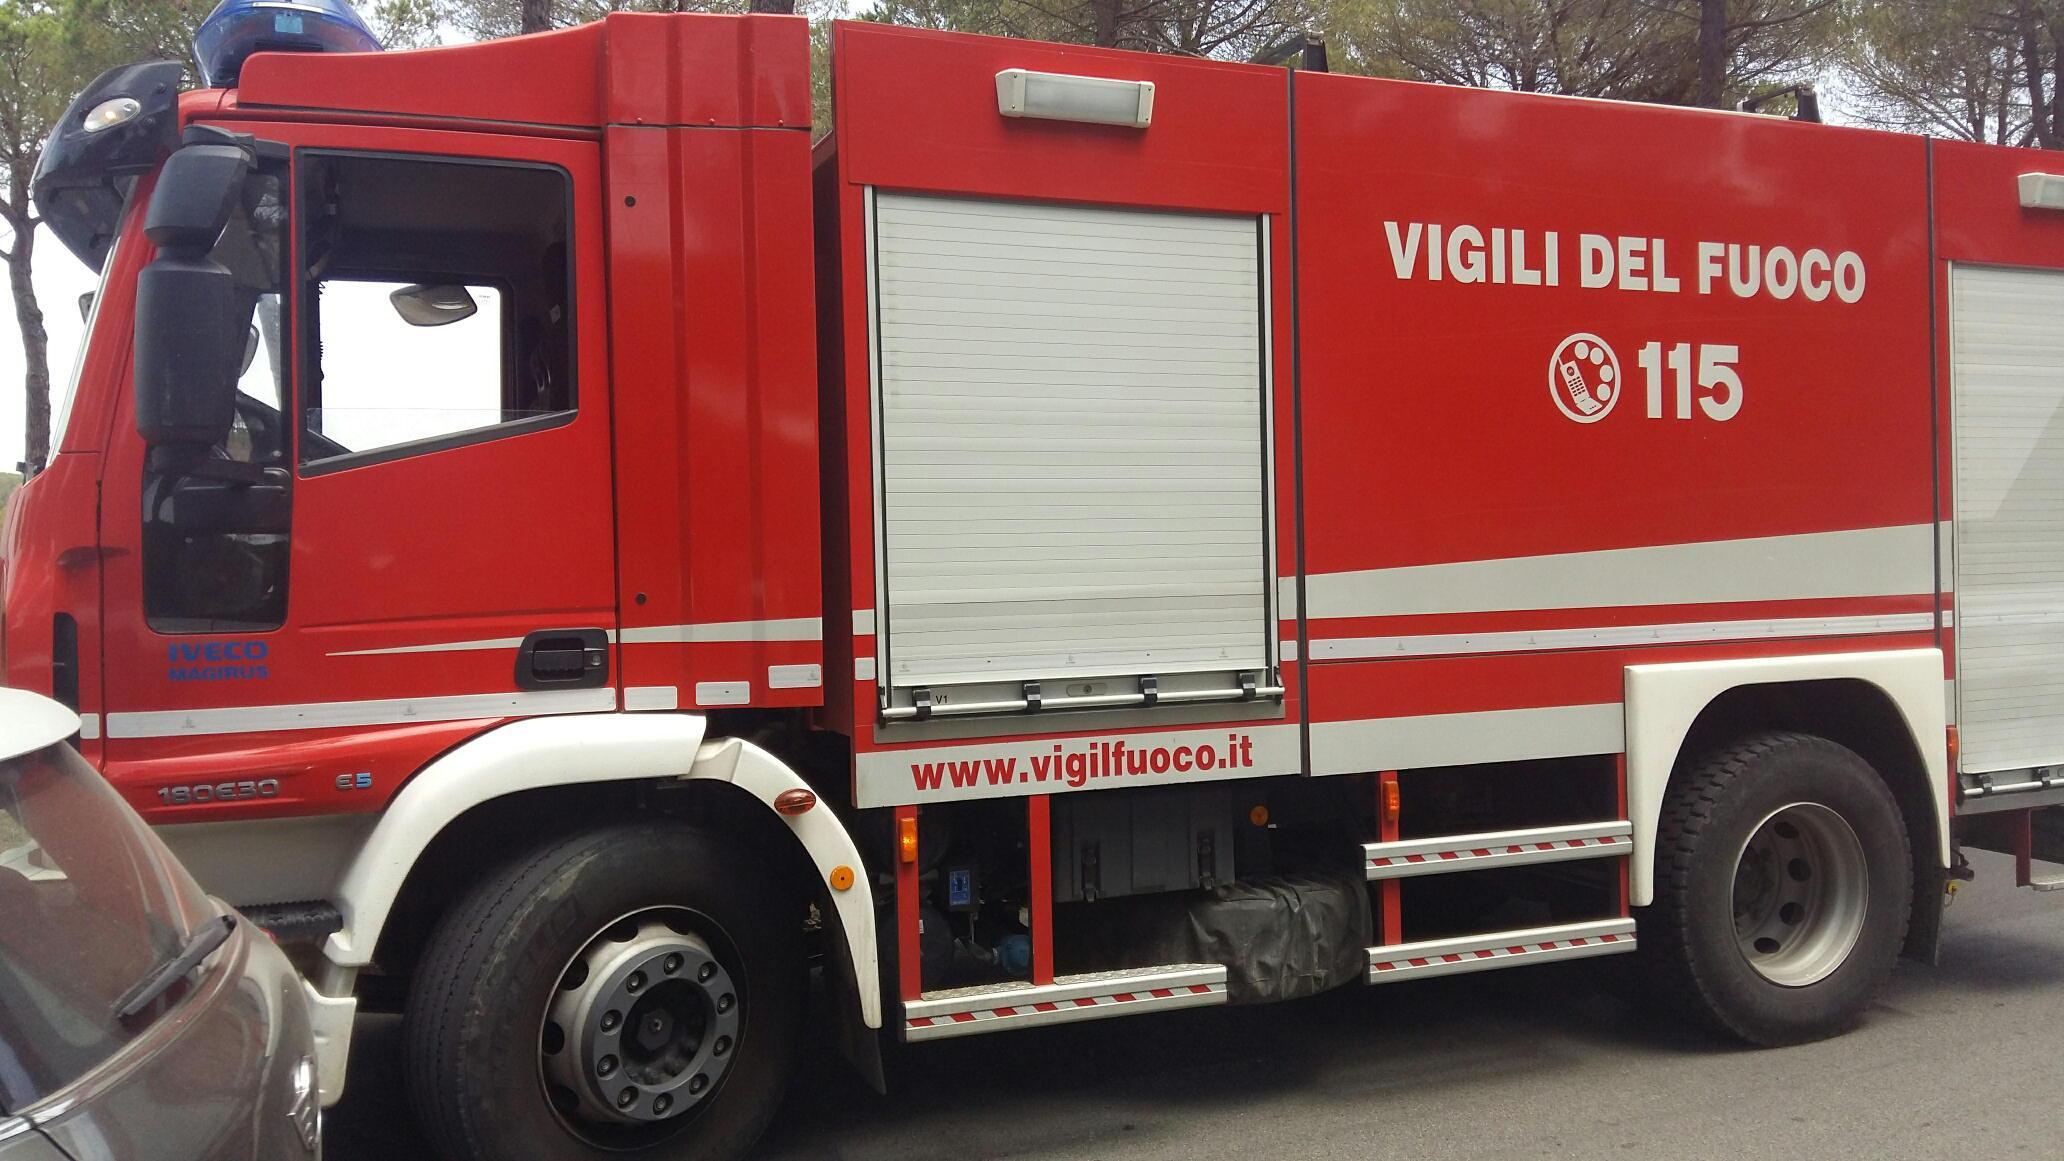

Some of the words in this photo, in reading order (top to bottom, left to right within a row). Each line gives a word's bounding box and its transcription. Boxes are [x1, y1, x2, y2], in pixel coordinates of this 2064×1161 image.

[1384, 221, 1559, 286] VIGILI
[1580, 234, 1680, 292] DEL
[1699, 241, 1866, 304] FUOCO
[1638, 341, 1744, 422] 115
[167, 641, 269, 662] IVECO
[168, 665, 270, 681] MAGIRUS
[936, 694, 948, 704] V1
[911, 733, 1253, 791] www.vigilfuoco.it
[158, 779, 279, 804] 180E30
